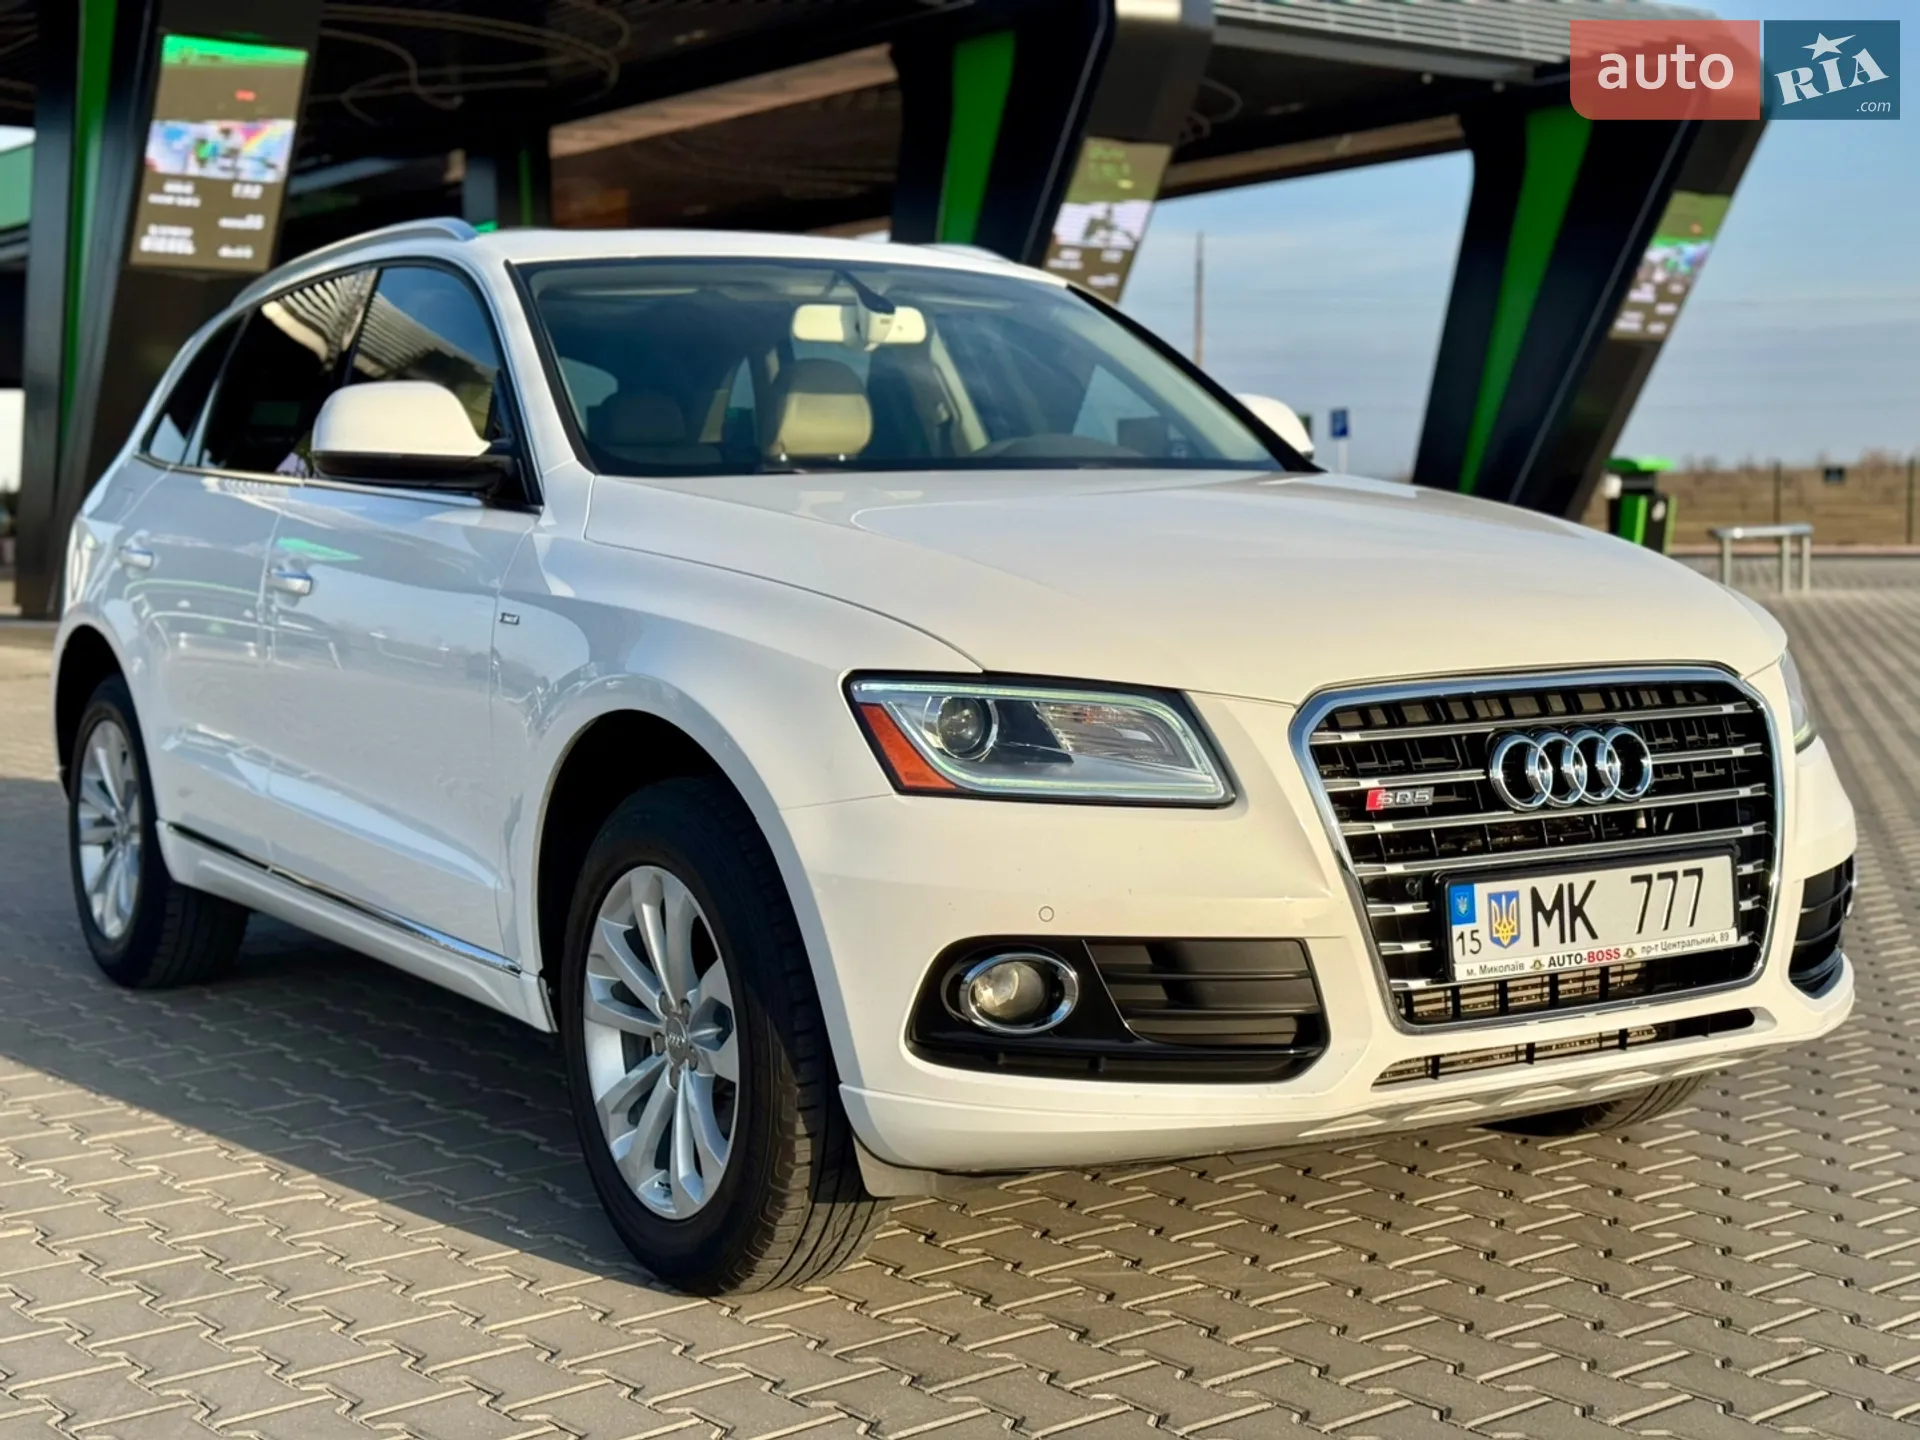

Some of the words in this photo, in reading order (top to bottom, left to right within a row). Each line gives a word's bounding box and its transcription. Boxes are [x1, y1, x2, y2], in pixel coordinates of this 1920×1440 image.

[1529, 879, 1599, 948] MK
[1630, 866, 1704, 935] 777
[1455, 929, 1483, 957] 15
